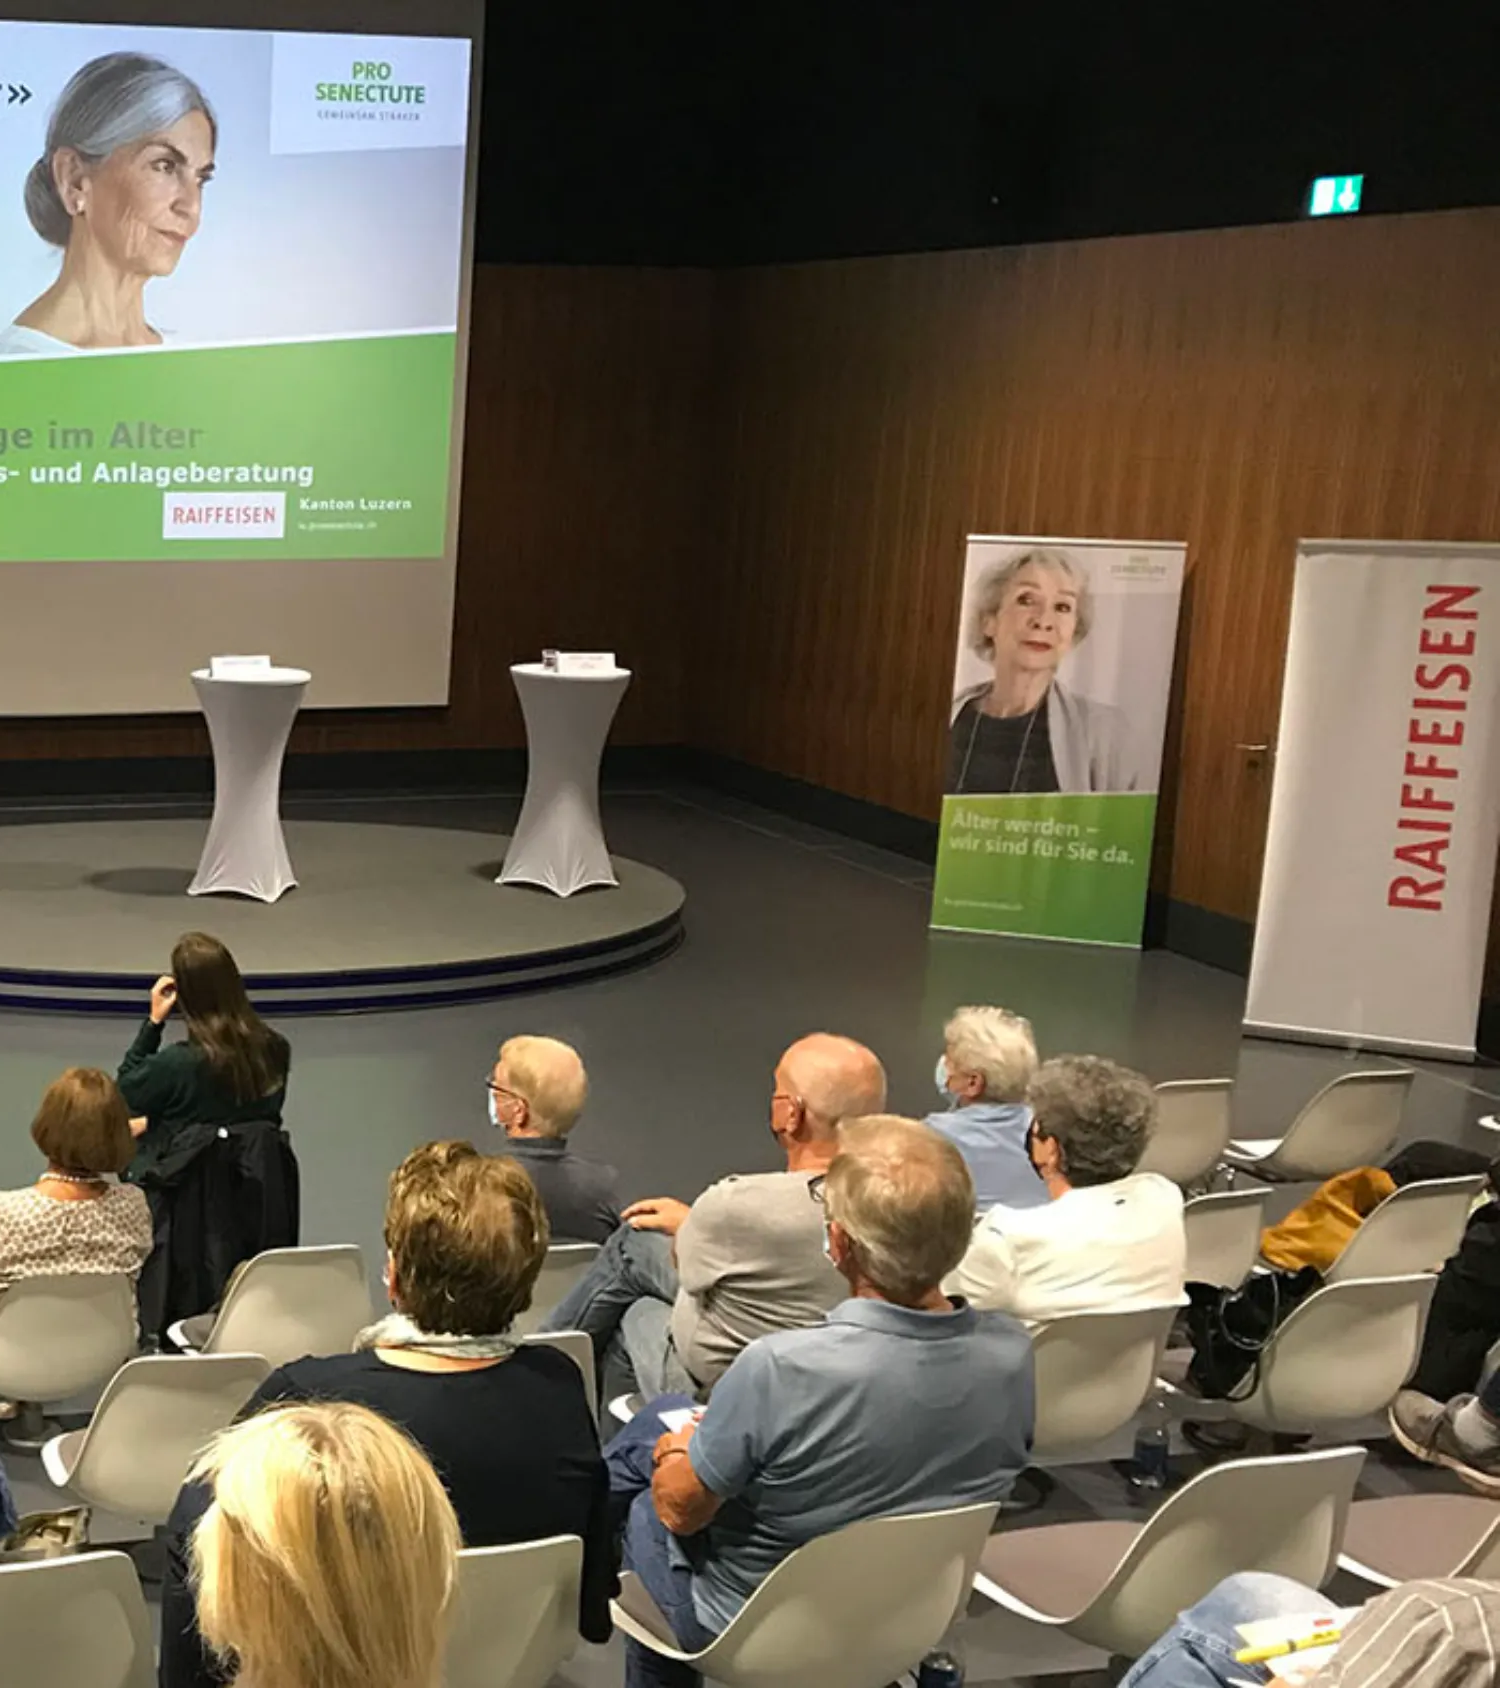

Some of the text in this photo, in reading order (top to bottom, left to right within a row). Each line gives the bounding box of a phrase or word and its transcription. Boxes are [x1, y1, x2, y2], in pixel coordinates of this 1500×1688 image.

[352, 61, 392, 80] PRO
[315, 82, 426, 104] SENECTUTE
[48, 420, 94, 449] im
[109, 421, 206, 450] Alter
[29, 462, 82, 484] und
[92, 462, 314, 488] Anlageberatung
[172, 506, 276, 525] RAIFFEISEN
[299, 498, 412, 511] Kanton Luzern
[1388, 584, 1482, 911] RAIFFEISEN
[950, 806, 999, 830] Älter
[1003, 816, 1079, 838] werden
[950, 831, 1135, 865] wir sind für Sie da.
